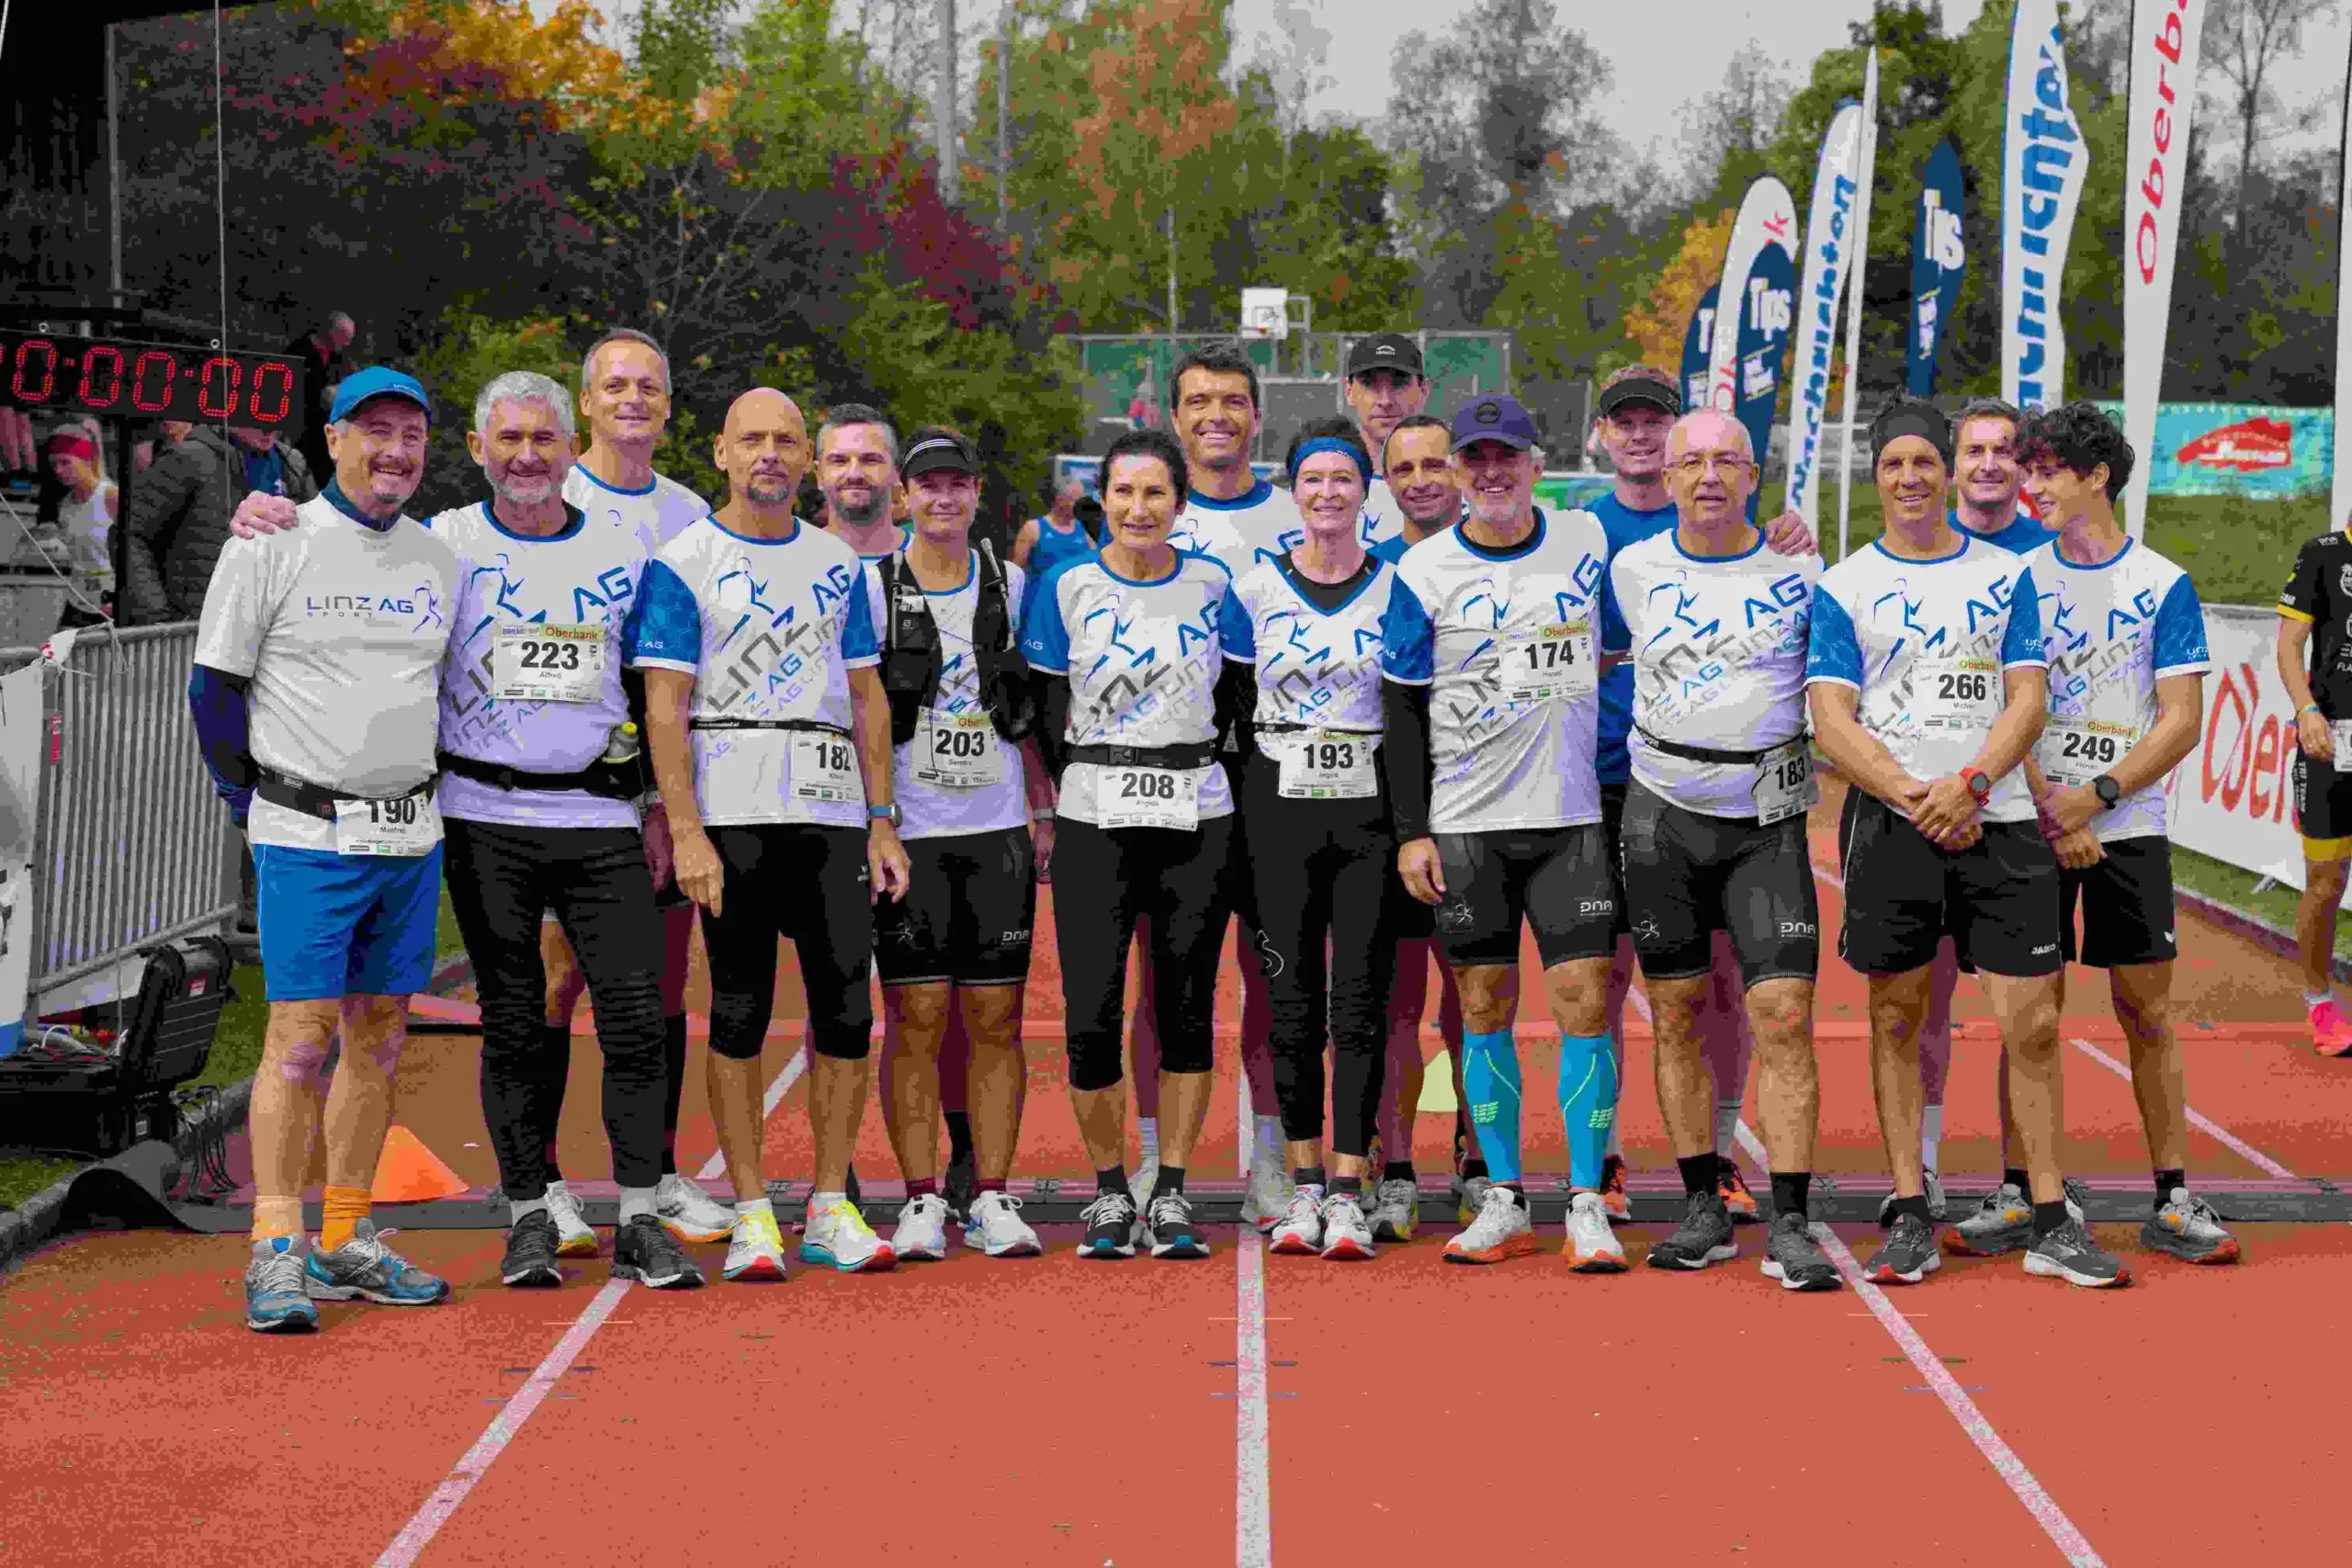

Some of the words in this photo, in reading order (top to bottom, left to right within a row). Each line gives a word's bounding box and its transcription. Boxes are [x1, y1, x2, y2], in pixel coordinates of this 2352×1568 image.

[2136, 0, 2189, 286] Oberb
[379, 598, 414, 614] AG
[572, 566, 634, 624] AG
[1745, 573, 1809, 628] AG
[521, 640, 579, 671] 223
[1524, 639, 1575, 670] 174
[1938, 673, 1986, 701] 266
[816, 742, 852, 772] 182
[935, 728, 985, 757] 203
[1303, 743, 1354, 770] 193
[2062, 732, 2116, 763] 249
[1121, 773, 1175, 799] 208
[1775, 755, 1805, 790] 183
[365, 798, 416, 825] 190
